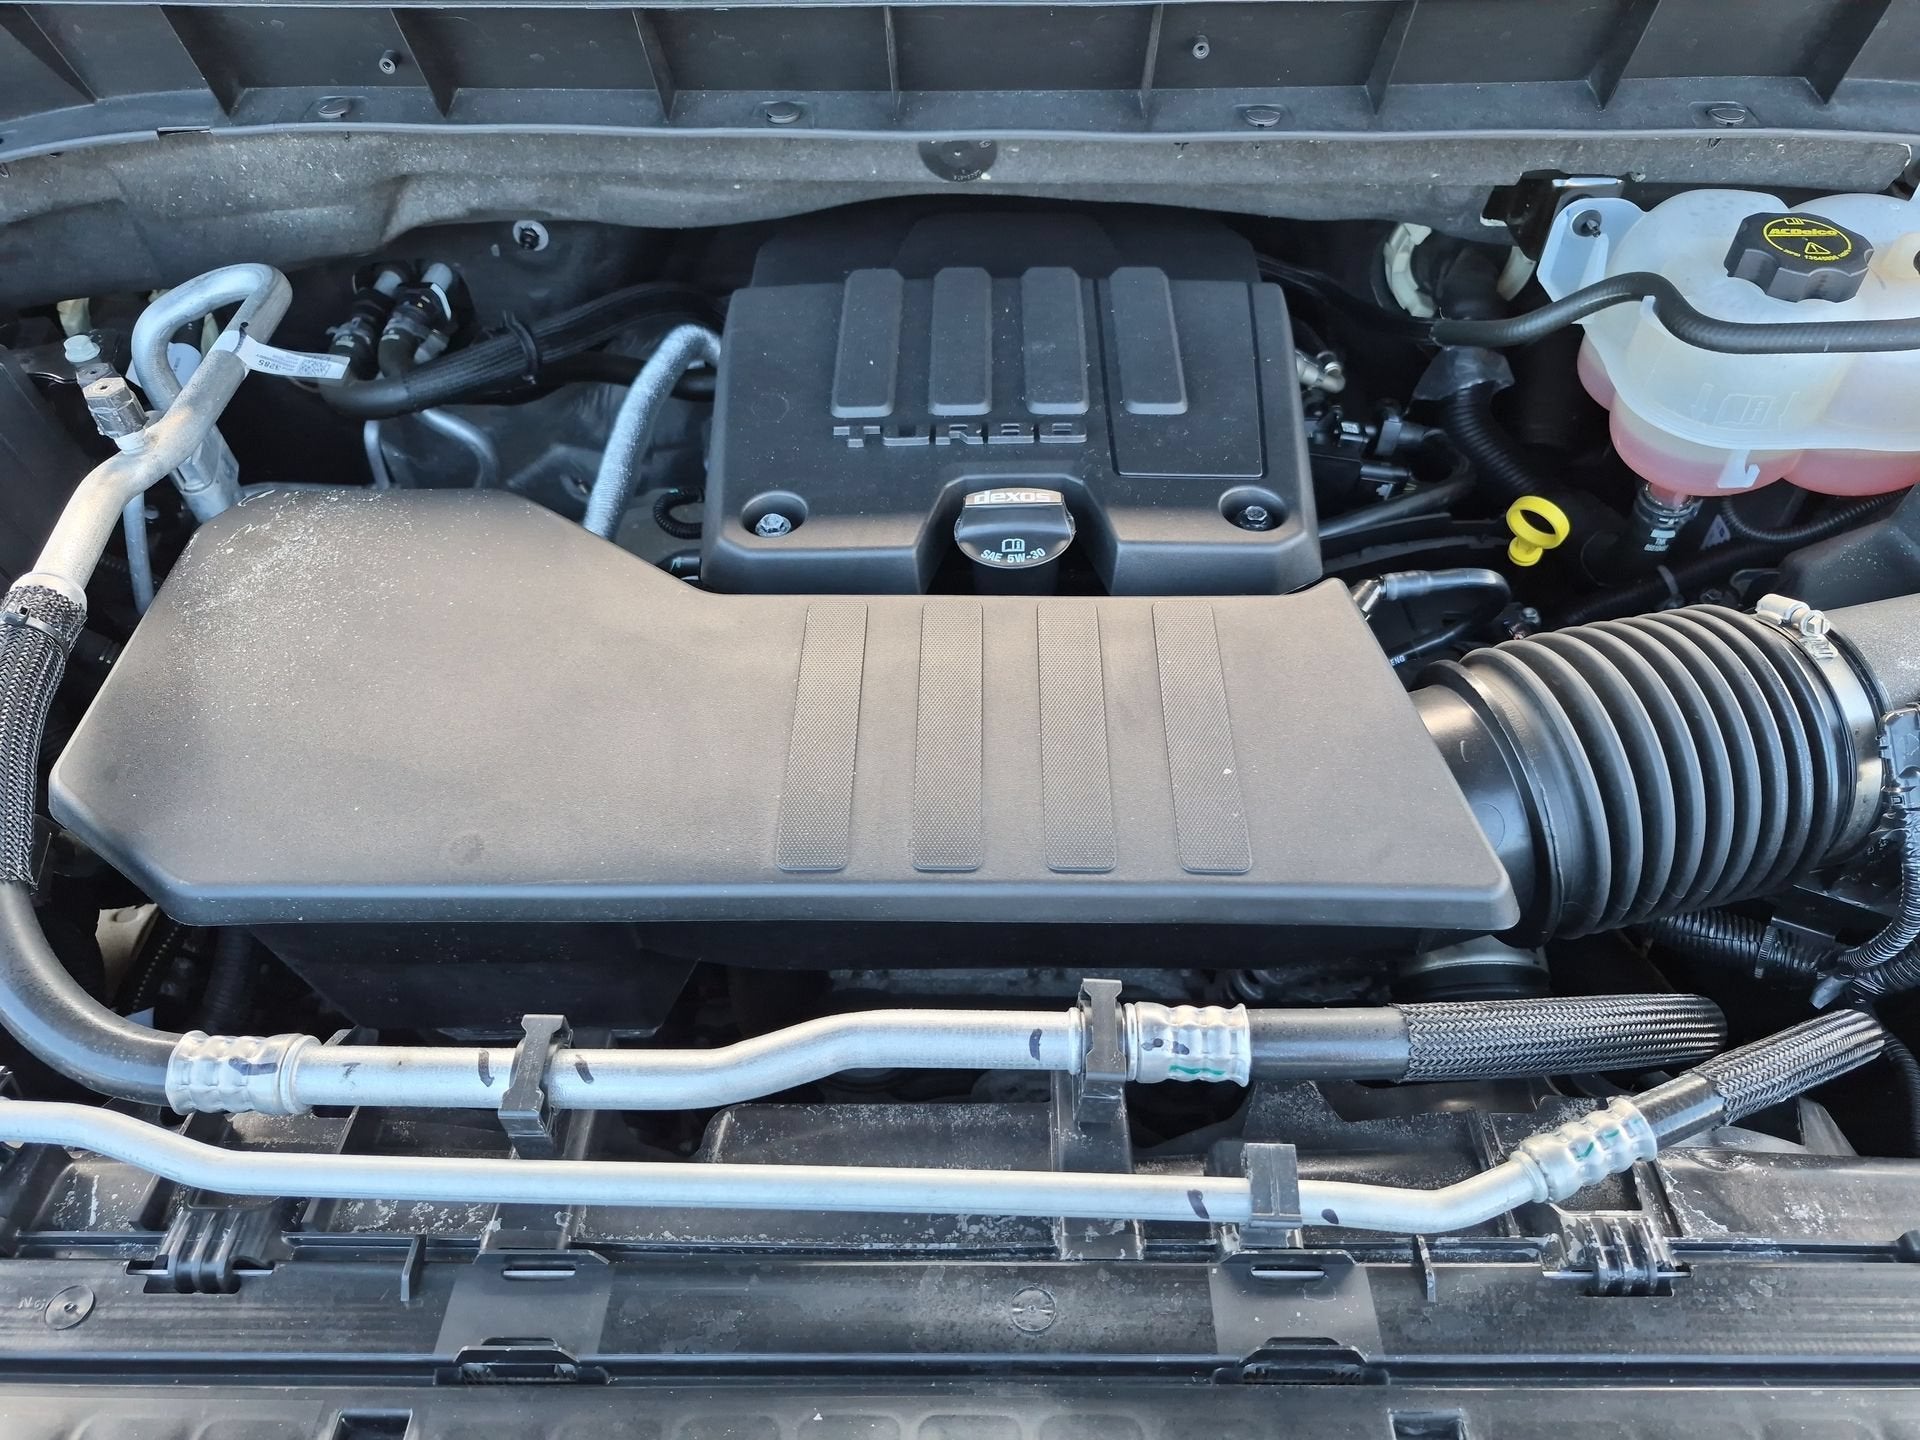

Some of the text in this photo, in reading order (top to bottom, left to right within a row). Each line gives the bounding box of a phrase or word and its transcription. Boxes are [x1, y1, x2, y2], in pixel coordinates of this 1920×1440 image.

[1768, 228, 1838, 236] ACDelco
[833, 419, 1087, 447] TURBO
[974, 490, 1050, 504] dexos
[980, 547, 1046, 563] SAE 5W-30
